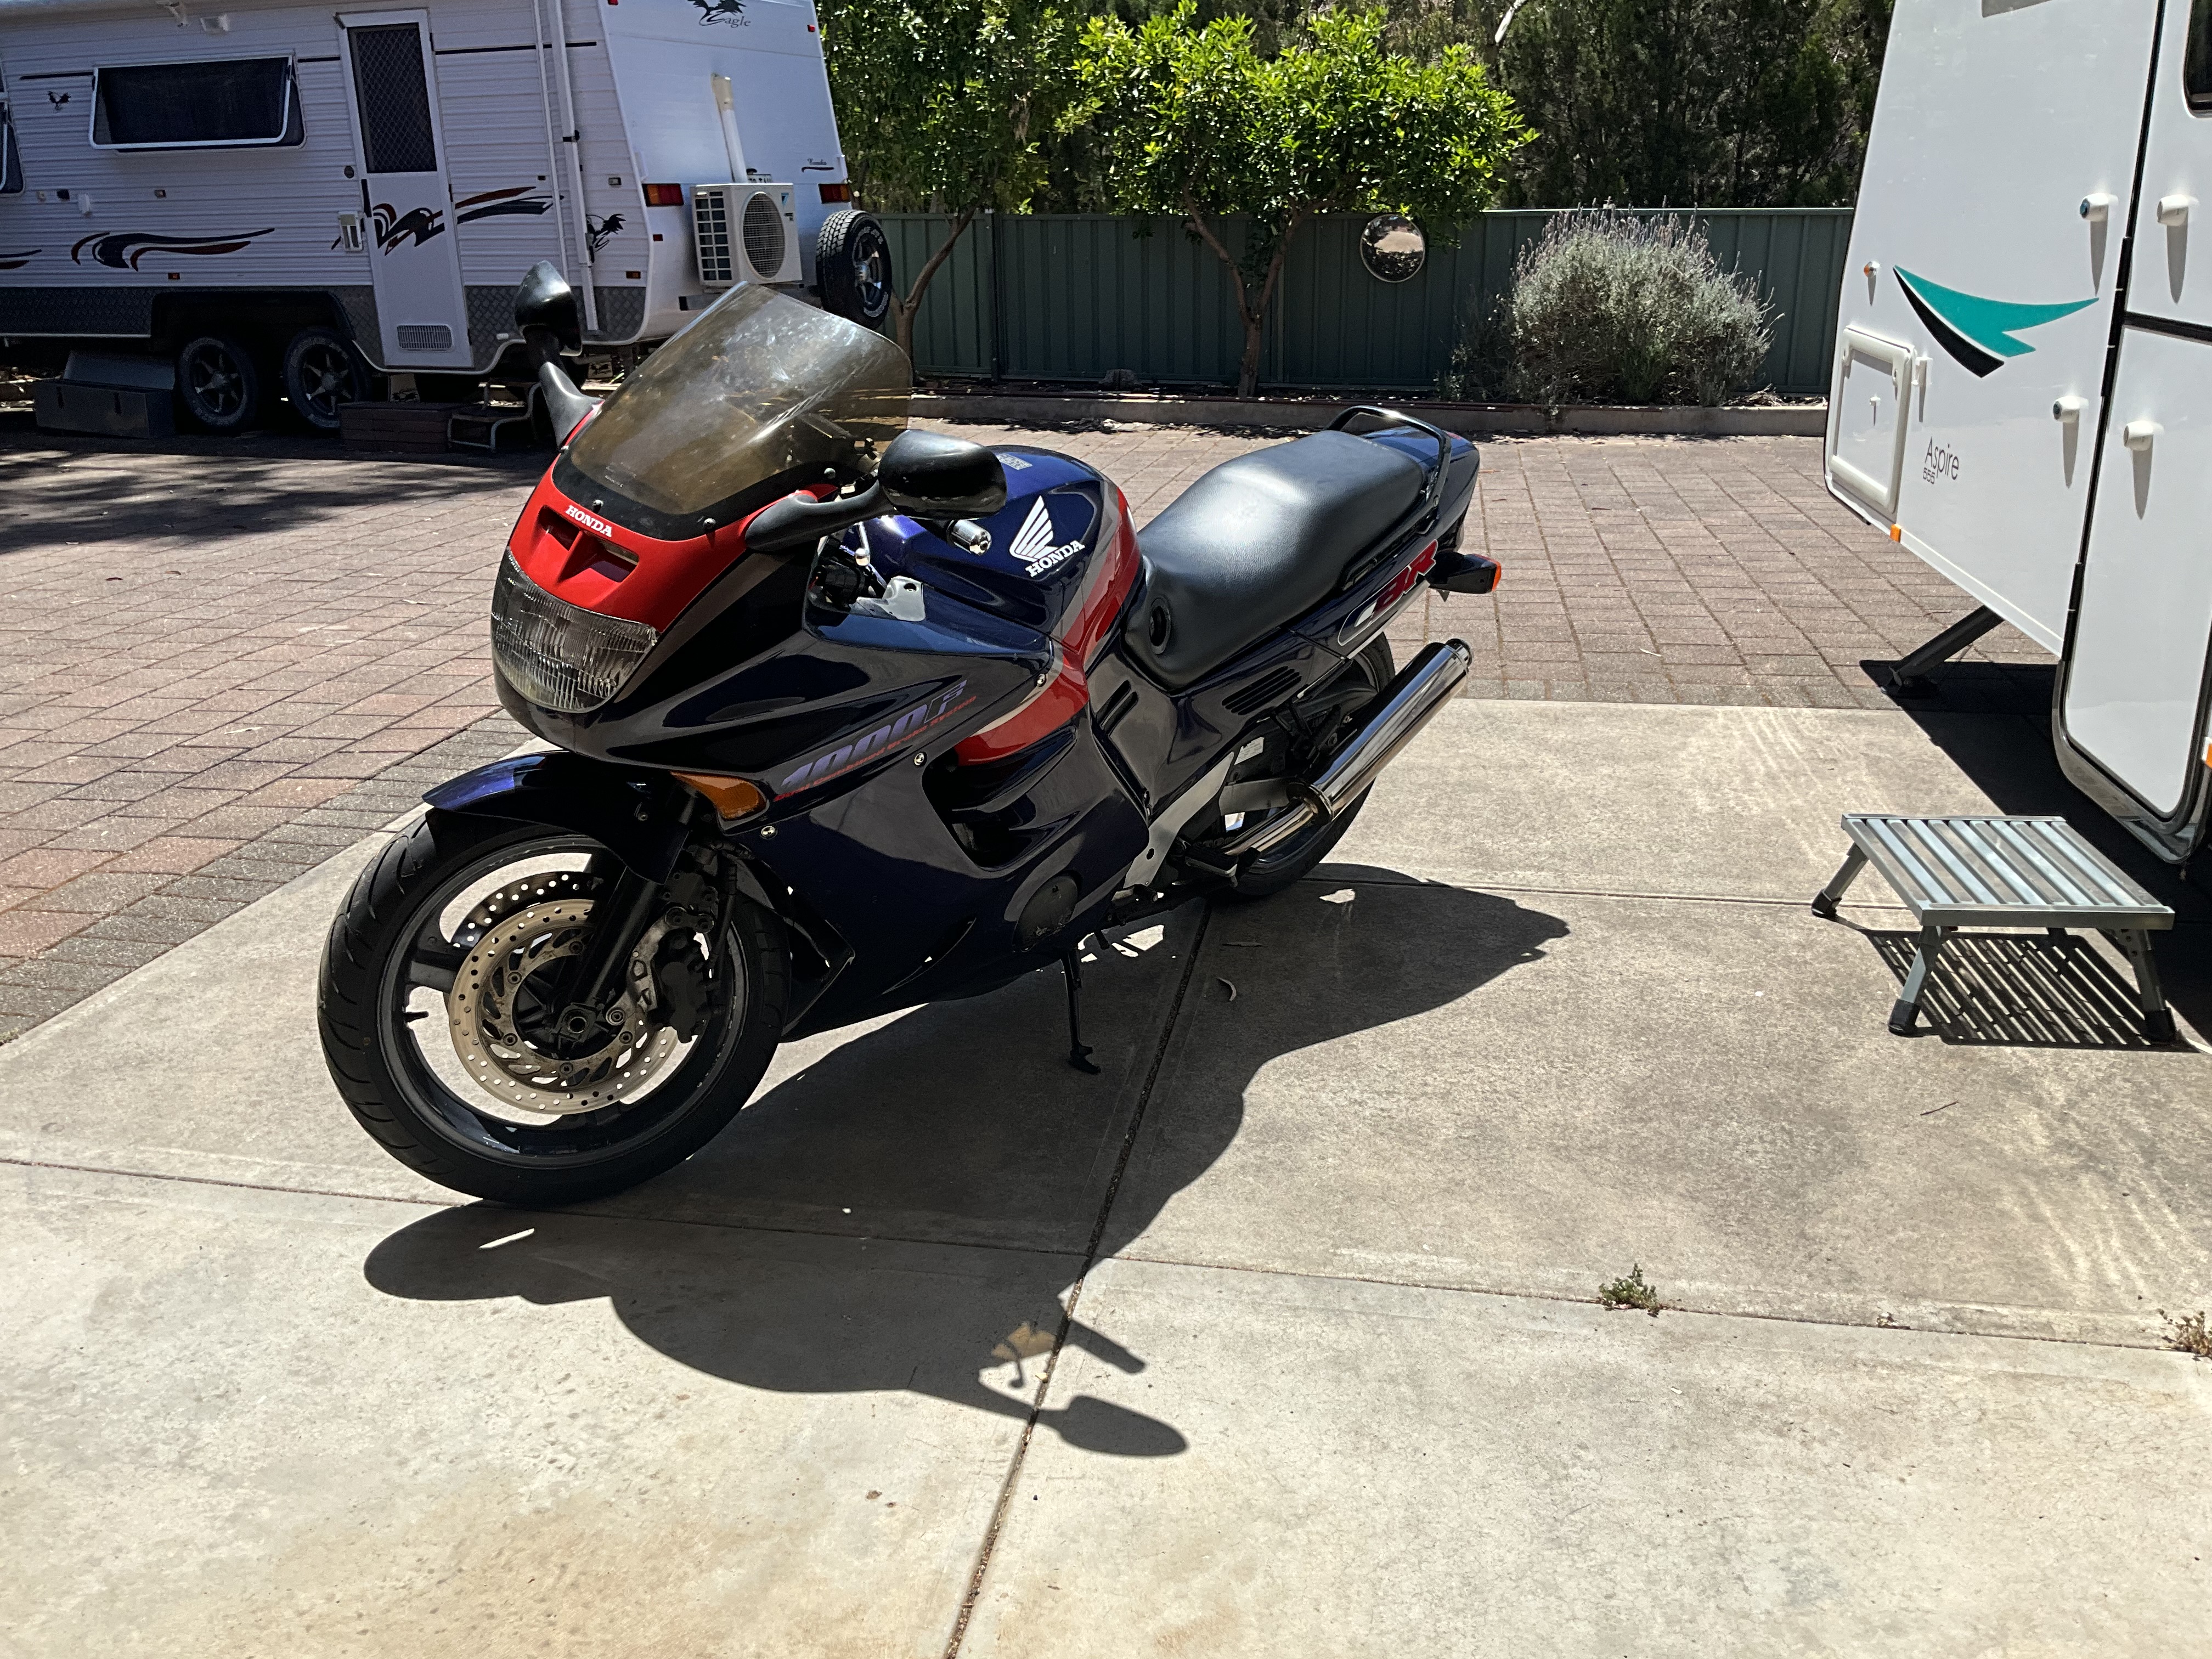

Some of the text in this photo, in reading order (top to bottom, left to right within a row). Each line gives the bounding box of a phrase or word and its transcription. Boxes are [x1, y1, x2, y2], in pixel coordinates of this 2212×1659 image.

[699, 12, 751, 29] Eagle
[1924, 436, 1959, 480] Aspire
[1922, 467, 1936, 484] 555
[565, 505, 612, 537] HONDA
[1025, 540, 1085, 577] HONDA
[1338, 539, 1438, 646] CBR
